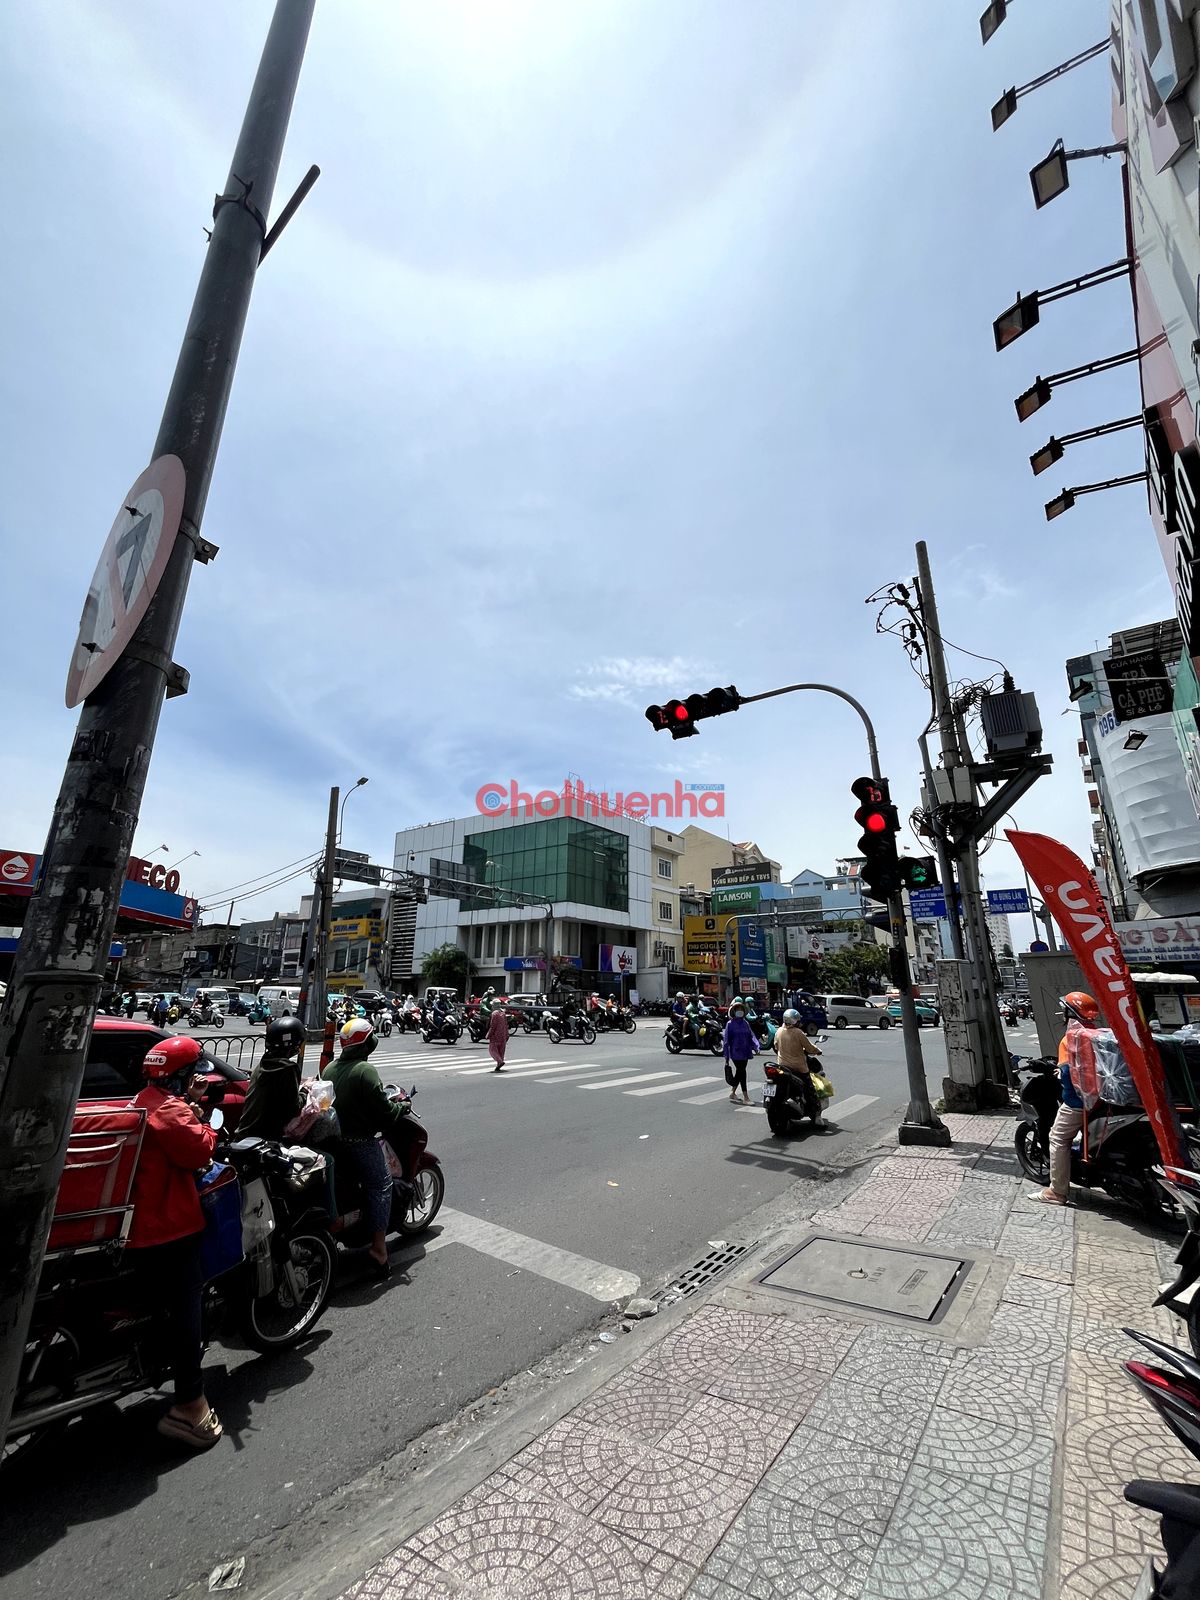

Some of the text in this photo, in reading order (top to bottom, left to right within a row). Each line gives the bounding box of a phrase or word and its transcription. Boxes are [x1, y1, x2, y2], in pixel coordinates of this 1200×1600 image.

[1122, 664, 1148, 686] TRÀ
[1117, 682, 1165, 709] CÀ PHÊ
[718, 892, 752, 902] LAMSON
